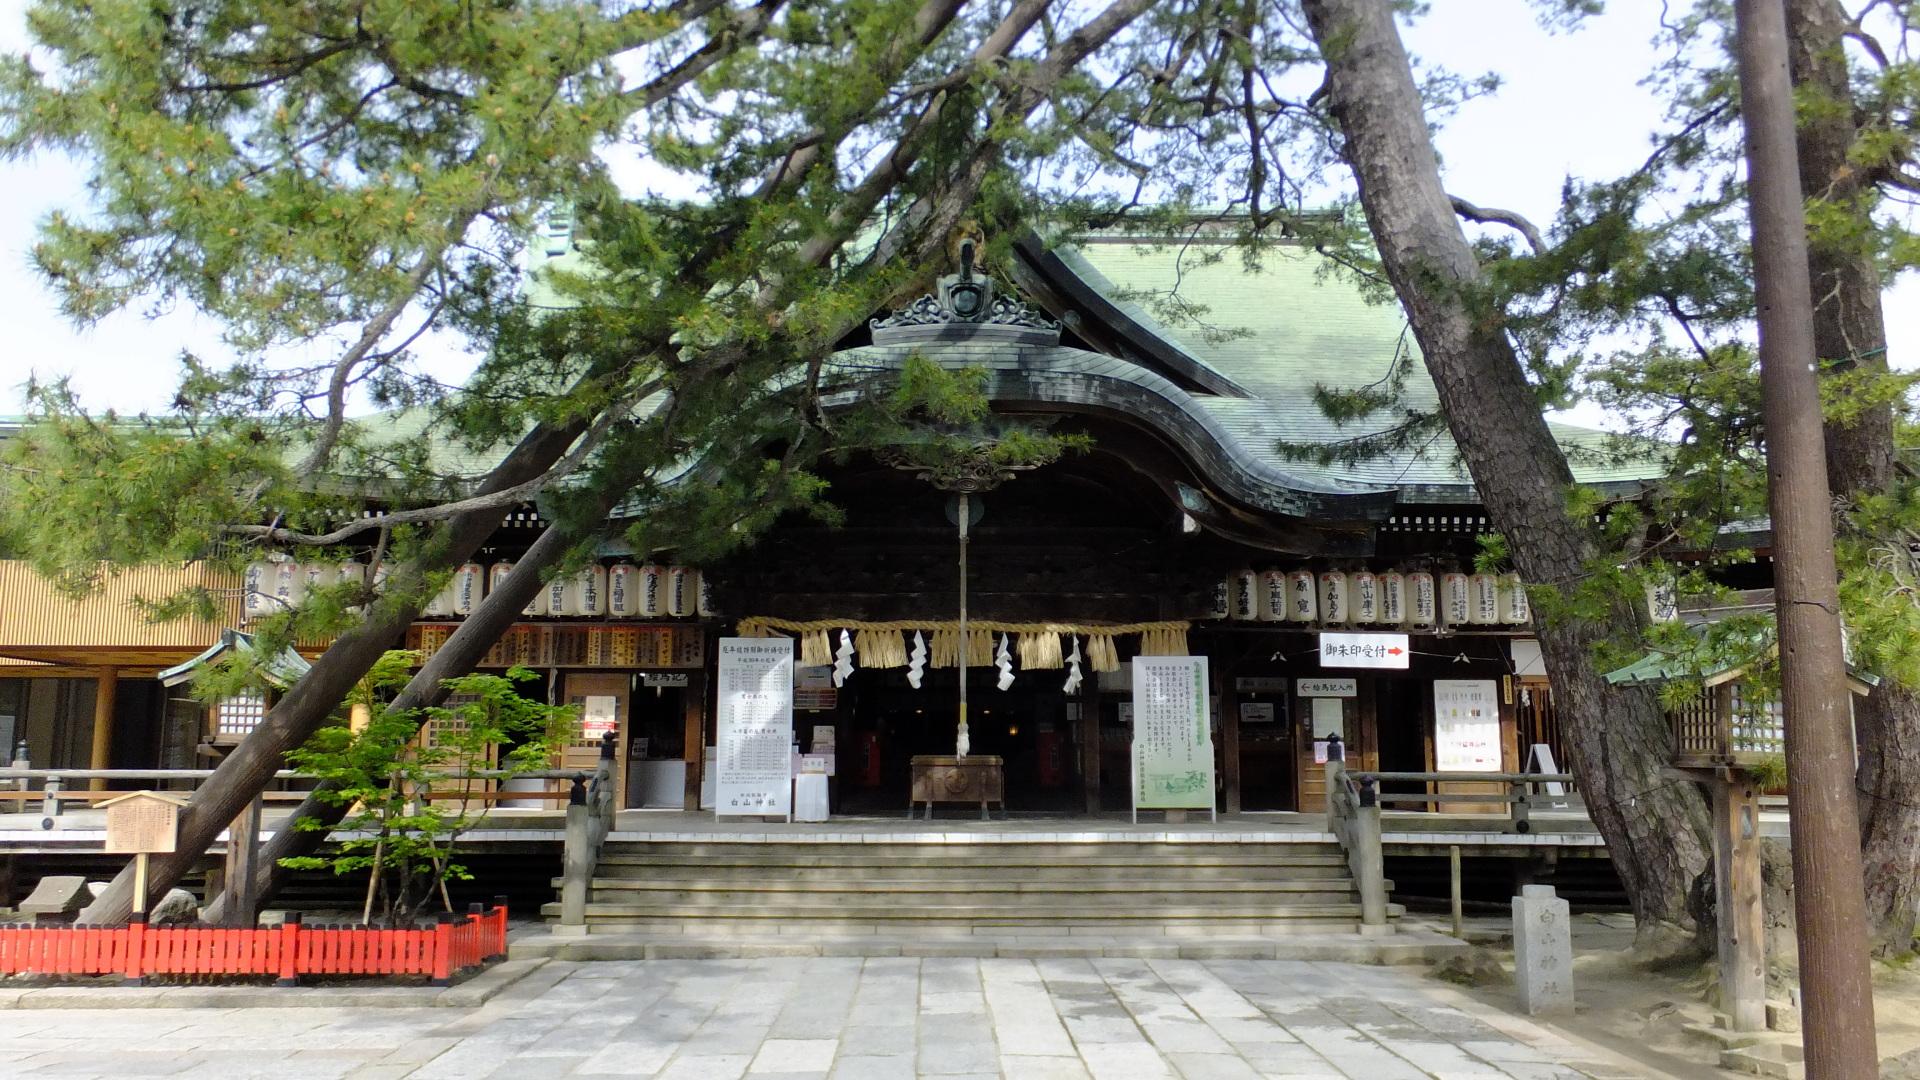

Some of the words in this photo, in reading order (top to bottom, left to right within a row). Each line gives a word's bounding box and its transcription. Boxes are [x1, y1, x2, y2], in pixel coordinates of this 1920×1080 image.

[1325, 643, 1386, 658] 御朱印受付
[731, 799, 776, 807] 白山神社
[1540, 908, 1560, 995] 白山神社
